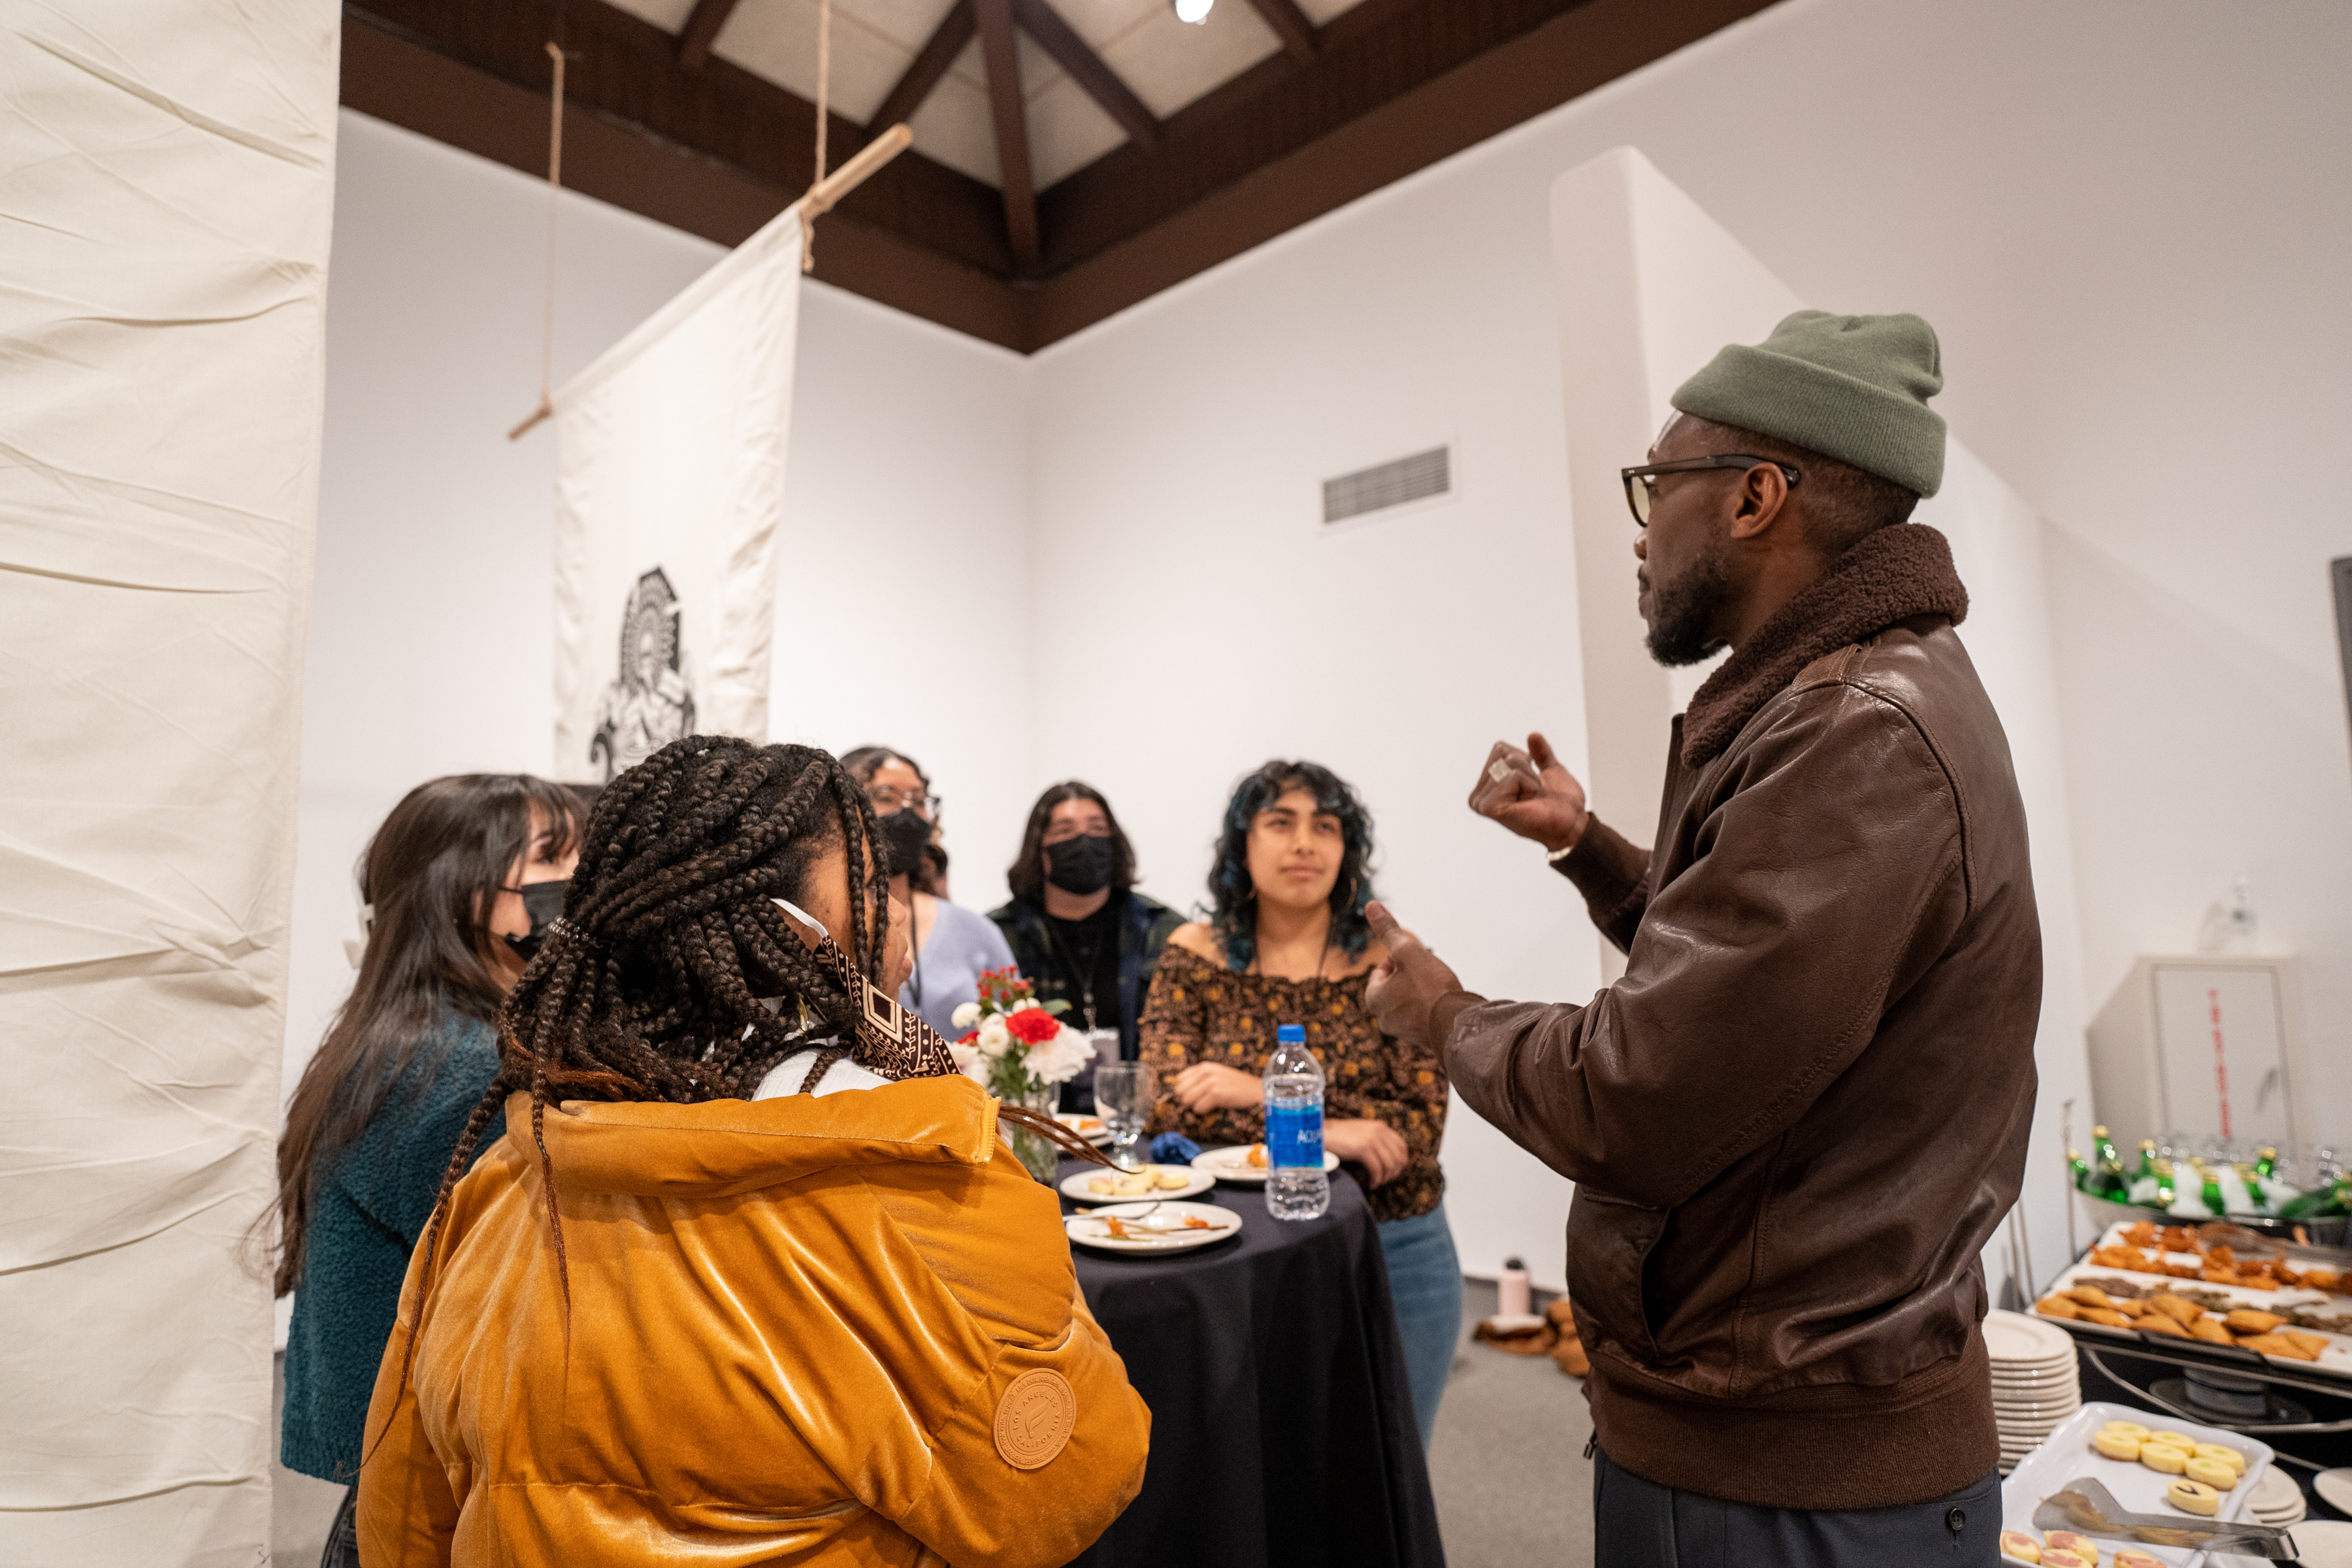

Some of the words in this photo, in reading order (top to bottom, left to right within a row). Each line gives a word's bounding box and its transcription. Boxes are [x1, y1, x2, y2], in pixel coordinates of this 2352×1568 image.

[1013, 1409, 1021, 1430] LOS
[1022, 1390, 1058, 1408] ANGELES
[1017, 1413, 1060, 1447] CALIFORNIA
